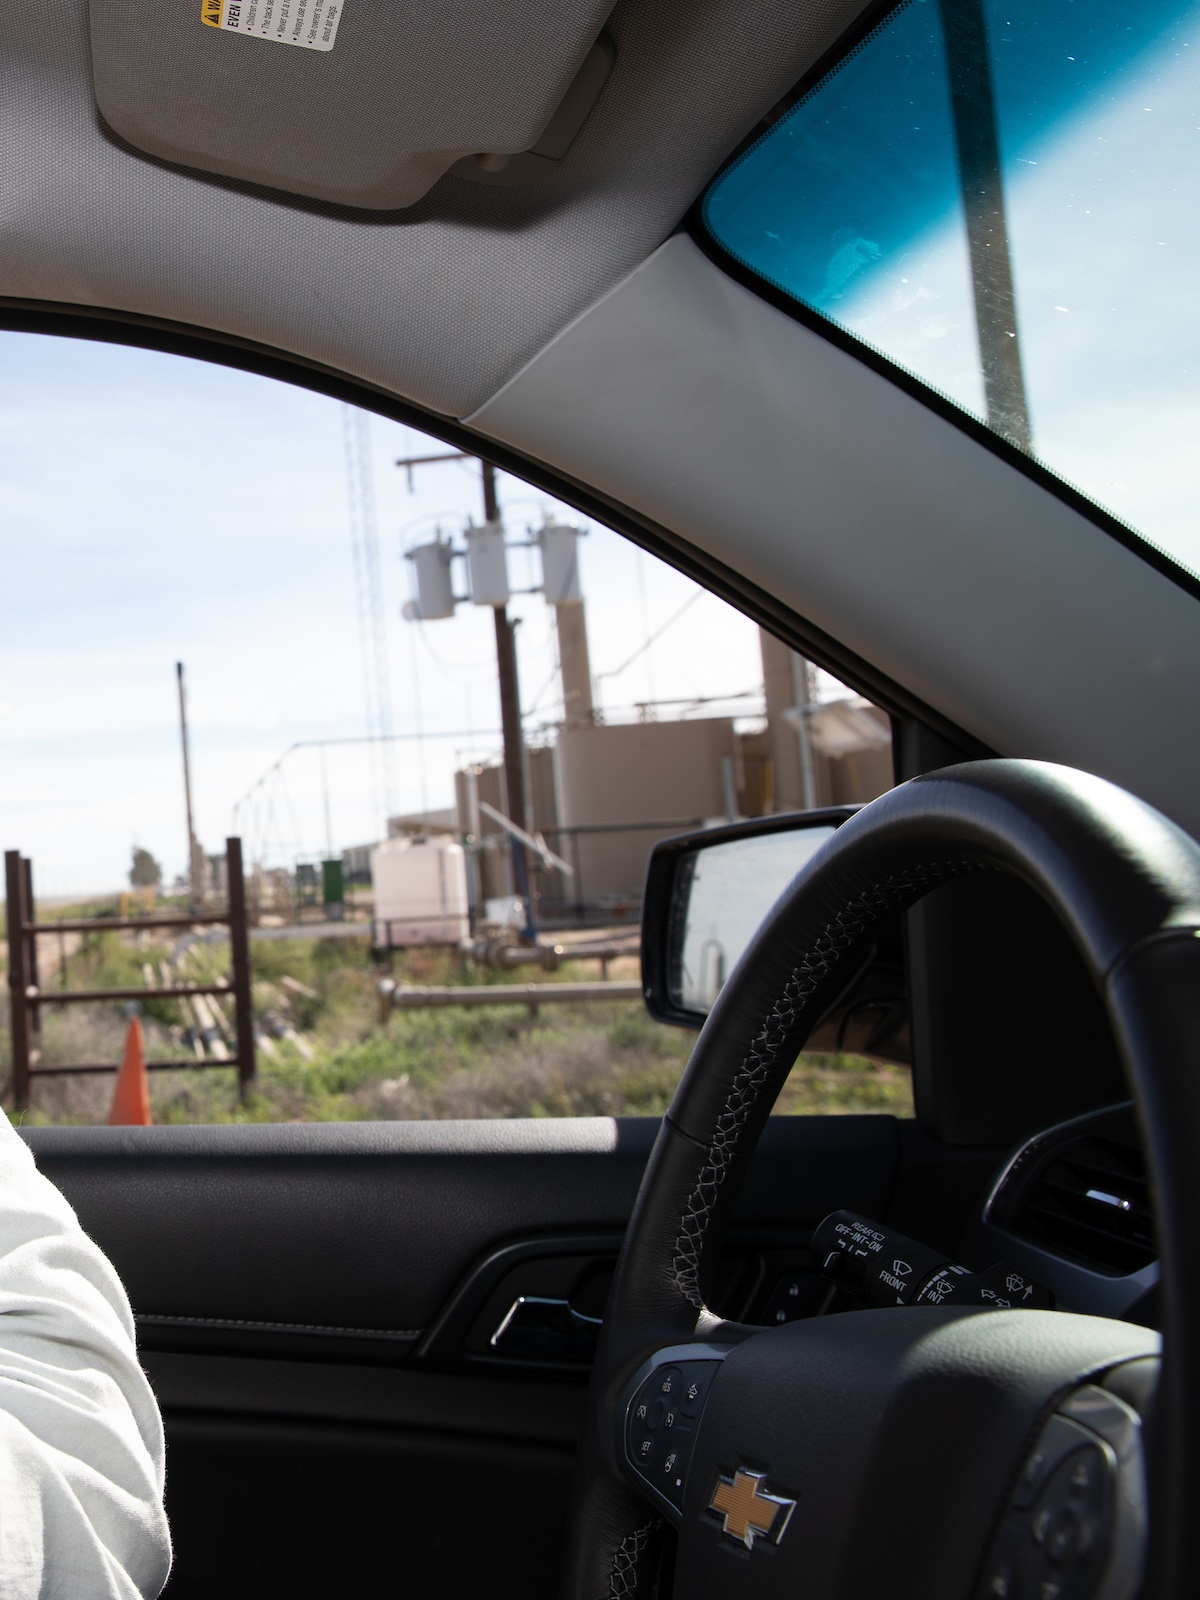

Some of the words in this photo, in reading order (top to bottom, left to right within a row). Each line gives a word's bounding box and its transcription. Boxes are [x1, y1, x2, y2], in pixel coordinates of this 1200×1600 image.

[227, 4, 241, 27] EVEN
[246, 5, 257, 26] Children
[263, 6, 273, 19] back
[281, 8, 289, 18] put
[311, 8, 321, 29] owner's
[326, 5, 337, 19] bags.
[261, 20, 270, 29] The
[277, 18, 286, 33] Never
[292, 18, 304, 36] Always
[325, 19, 333, 27] air
[307, 29, 317, 39] See
[322, 27, 331, 42] about
[851, 1221, 874, 1237] REAR
[879, 1270, 907, 1292] FRONT
[927, 1290, 944, 1304] INT
